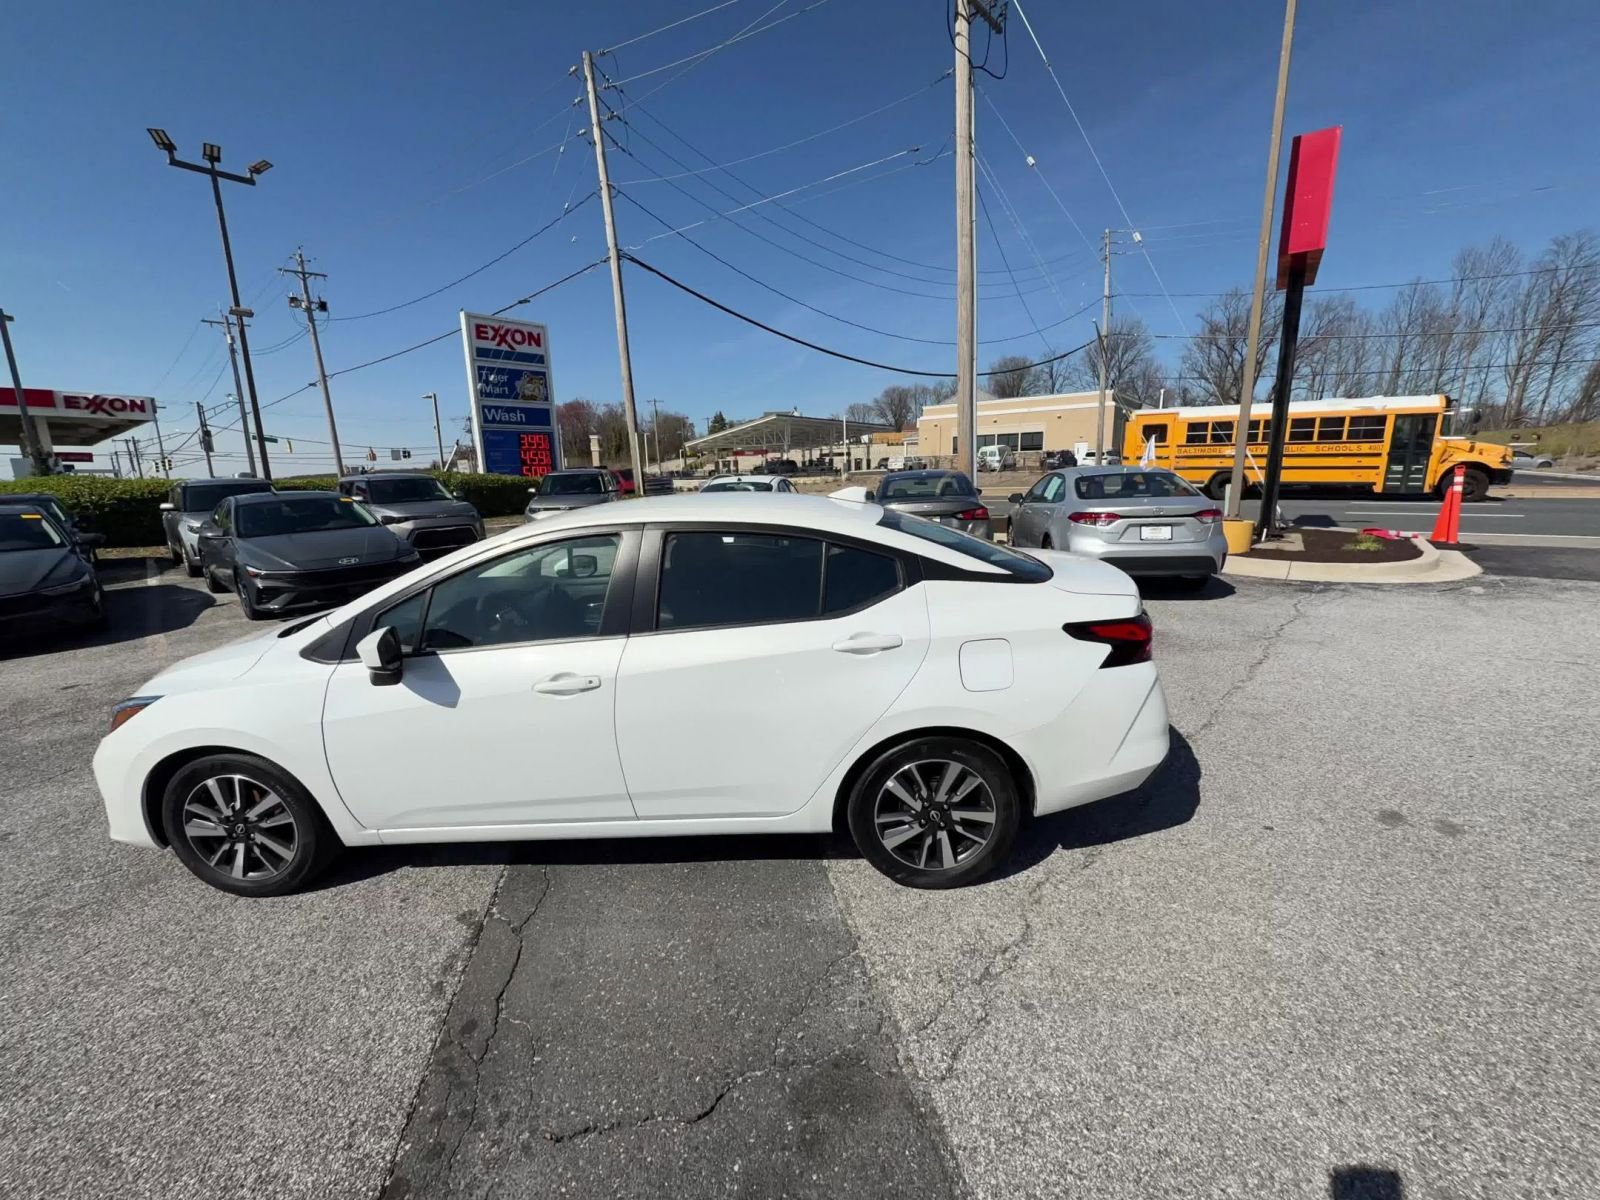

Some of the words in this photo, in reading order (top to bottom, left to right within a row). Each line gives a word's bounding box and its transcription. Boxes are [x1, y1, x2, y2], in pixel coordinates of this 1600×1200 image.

[475, 324, 542, 351] EXXON
[480, 370, 509, 384] Tger
[482, 383, 509, 395] Mart
[63, 395, 147, 417] EXXON
[484, 408, 526, 423] Wash
[1176, 447, 1222, 455] BALTIMORE
[1315, 444, 1363, 453] SCHOOLS
